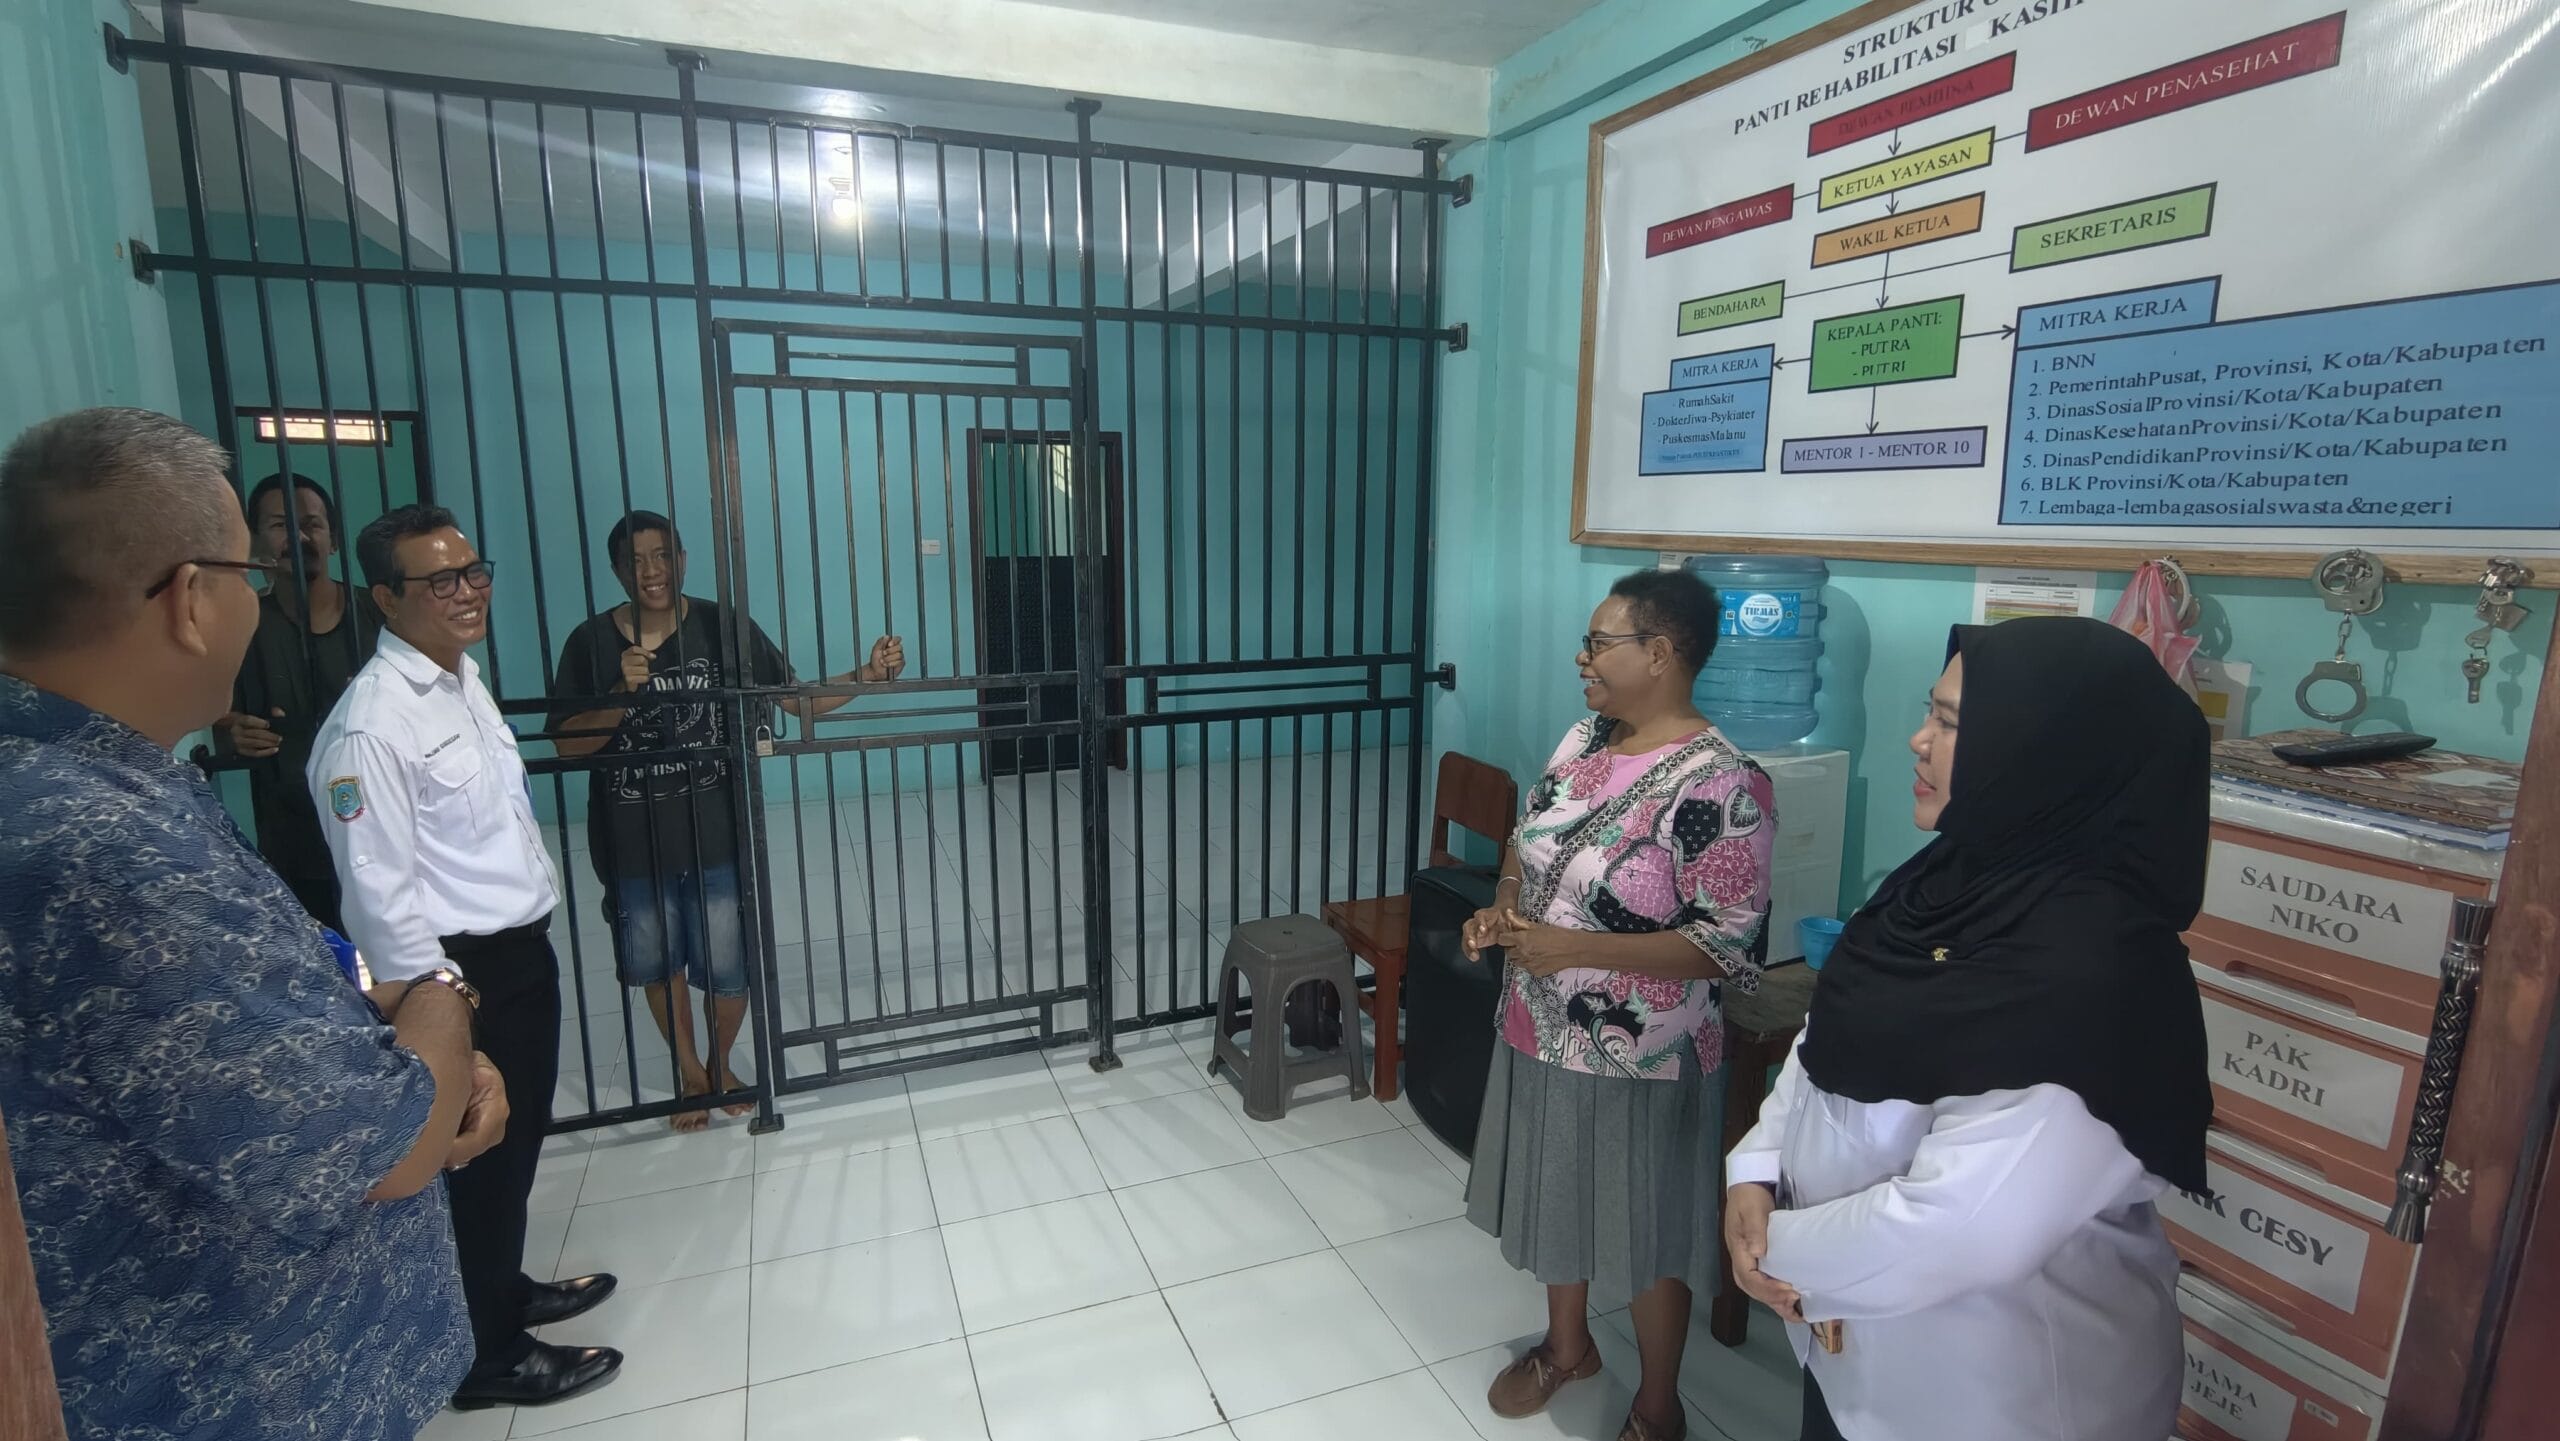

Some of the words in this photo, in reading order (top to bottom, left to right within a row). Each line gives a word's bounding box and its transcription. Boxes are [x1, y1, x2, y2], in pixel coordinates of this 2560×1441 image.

[1843, 0, 1975, 64] STRUKTUR
[1733, 102, 1790, 135] PANTI
[1795, 34, 1958, 112] REHABILITASI
[1989, 0, 2084, 38] KASI
[2056, 91, 2138, 130] DEWAN
[2145, 41, 2300, 102] PENASEHAT
[1833, 171, 1885, 199] KETUA
[1891, 146, 1972, 182] YAYASAN
[1662, 222, 1702, 244] DEWAN
[1704, 202, 1772, 233] PENGAWAS
[1840, 226, 1889, 251] WAKIL
[1893, 213, 1951, 239] KETUA
[2040, 206, 2176, 249] SEKRETARIS
[1693, 296, 1766, 320] BENDAHARA
[1828, 321, 1885, 341] KEPALA
[1890, 312, 1943, 331] PANTI:
[2039, 308, 2106, 332] MITRA
[2114, 297, 2187, 321] KERJA
[1860, 340, 1911, 356] PUTRA
[2028, 381, 2042, 397] 2.
[2215, 355, 2313, 381] Provinsi,
[2323, 335, 2546, 372] Kota/Kabupaten
[2032, 359, 2045, 374] 1.
[2052, 352, 2097, 372] BNN
[1682, 362, 1719, 379] MITRA
[1721, 358, 1759, 375] KERJA
[1861, 361, 1906, 378] PUTRI
[2026, 405, 2041, 421] 3.
[1794, 447, 1853, 462] MENTOR
[1878, 441, 1947, 458] MENTOR
[1953, 439, 1970, 455] 10
[2023, 428, 2039, 444] 4.
[2022, 453, 2036, 469] 5.
[2020, 477, 2035, 492] 6.
[2040, 476, 2082, 492] BLK
[2087, 470, 2349, 491] Provinsi/Kota/Kabupaten
[2019, 500, 2032, 515] 7.
[2240, 866, 2404, 924] SAUDARA
[2269, 903, 2359, 944] NIKO
[2245, 1030, 2310, 1072] PAK
[2223, 1052, 2326, 1107] KADRI
[2239, 1207, 2334, 1267] CESY
[2187, 1352, 2258, 1409] MAMA
[2190, 1380, 2244, 1421] JEJE
